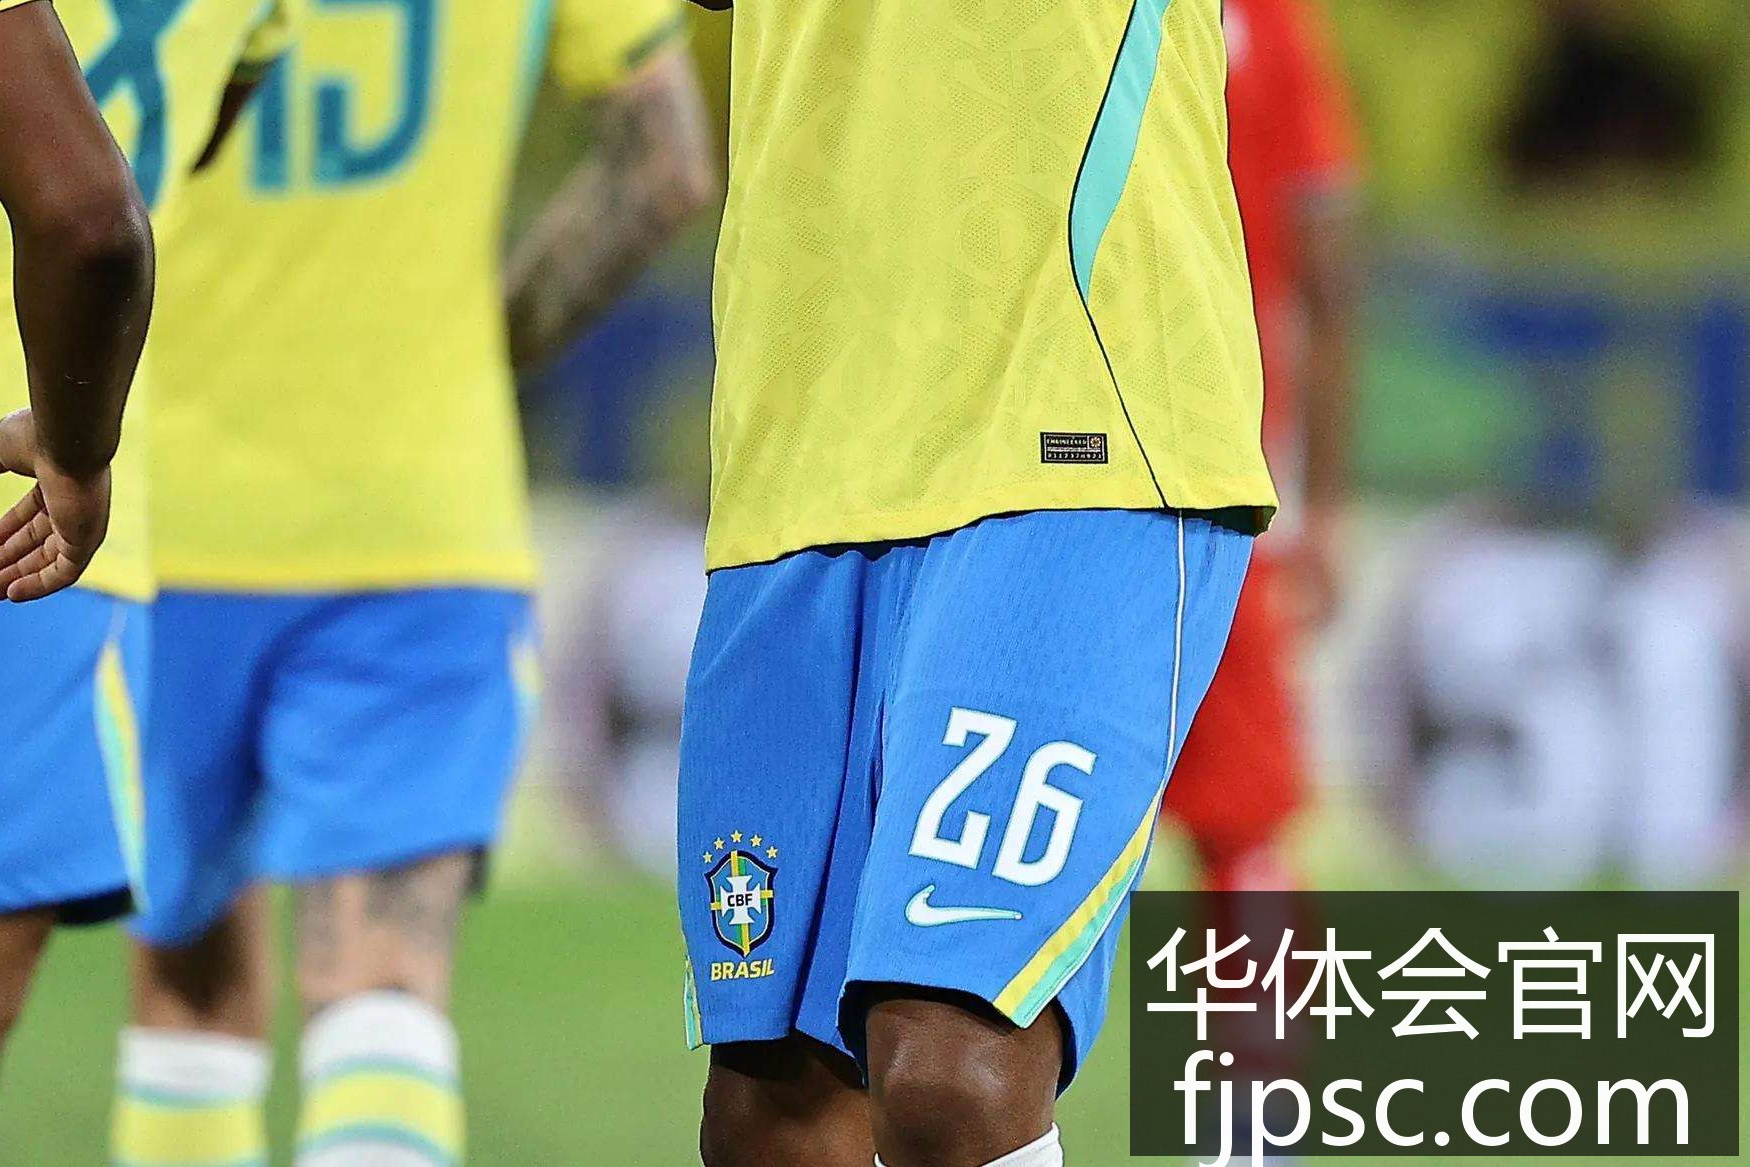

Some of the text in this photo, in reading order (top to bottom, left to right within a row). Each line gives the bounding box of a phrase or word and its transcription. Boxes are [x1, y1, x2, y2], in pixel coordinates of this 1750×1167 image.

[907, 705, 1098, 888] 26
[727, 893, 753, 907] CBF
[711, 958, 776, 982] BRASIL
